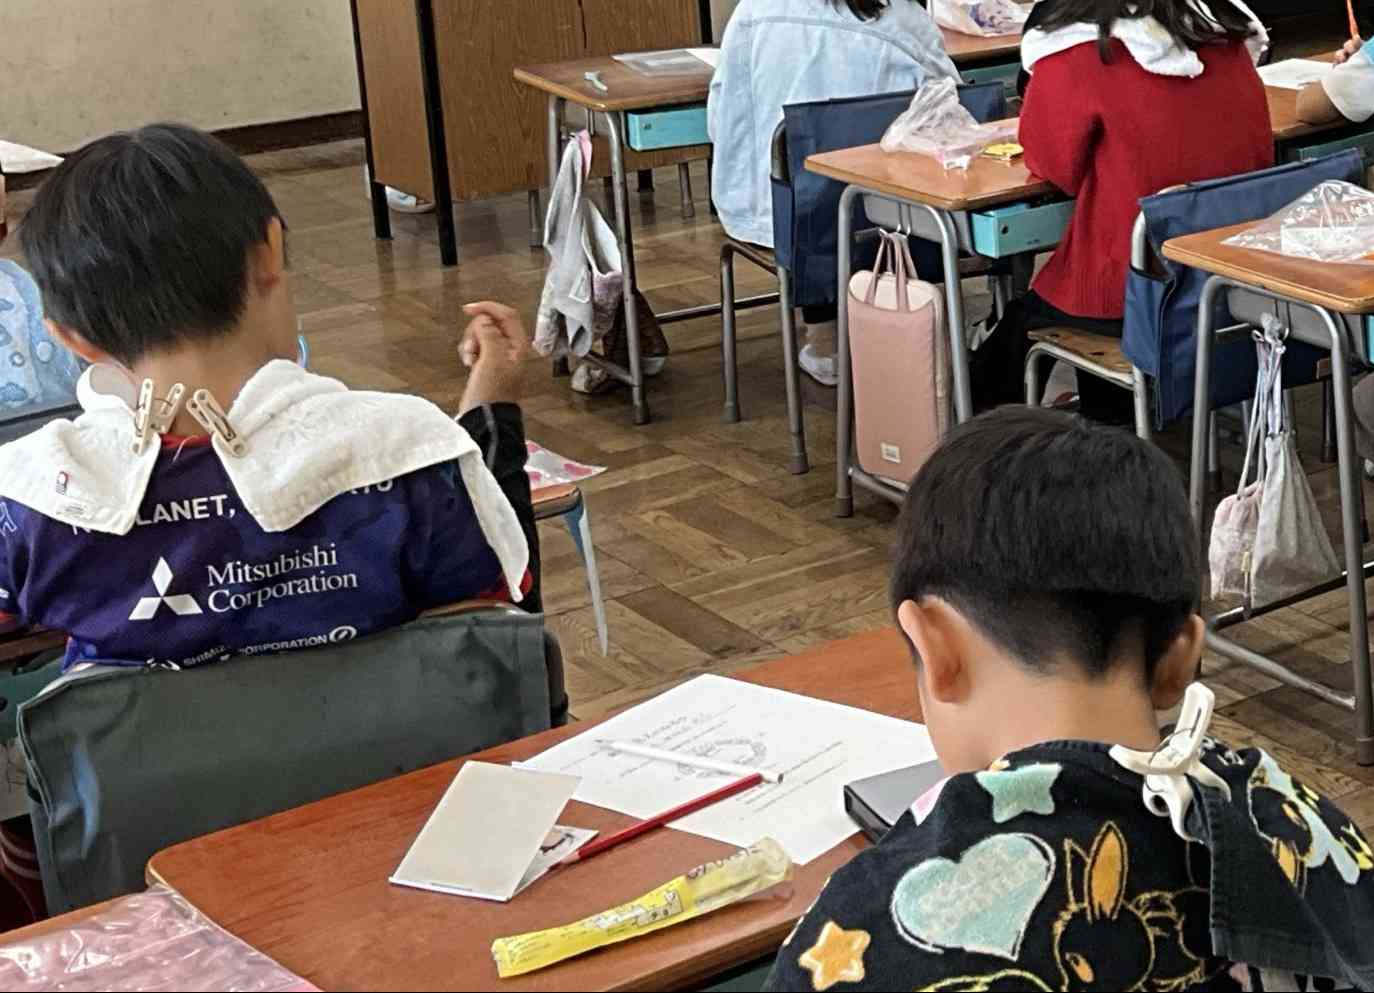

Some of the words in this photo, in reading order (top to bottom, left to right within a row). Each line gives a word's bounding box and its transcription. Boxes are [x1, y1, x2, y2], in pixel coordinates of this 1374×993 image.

[134, 494, 236, 526] LANET,
[207, 543, 338, 587] Mitsubishi
[207, 571, 359, 613] Corporation
